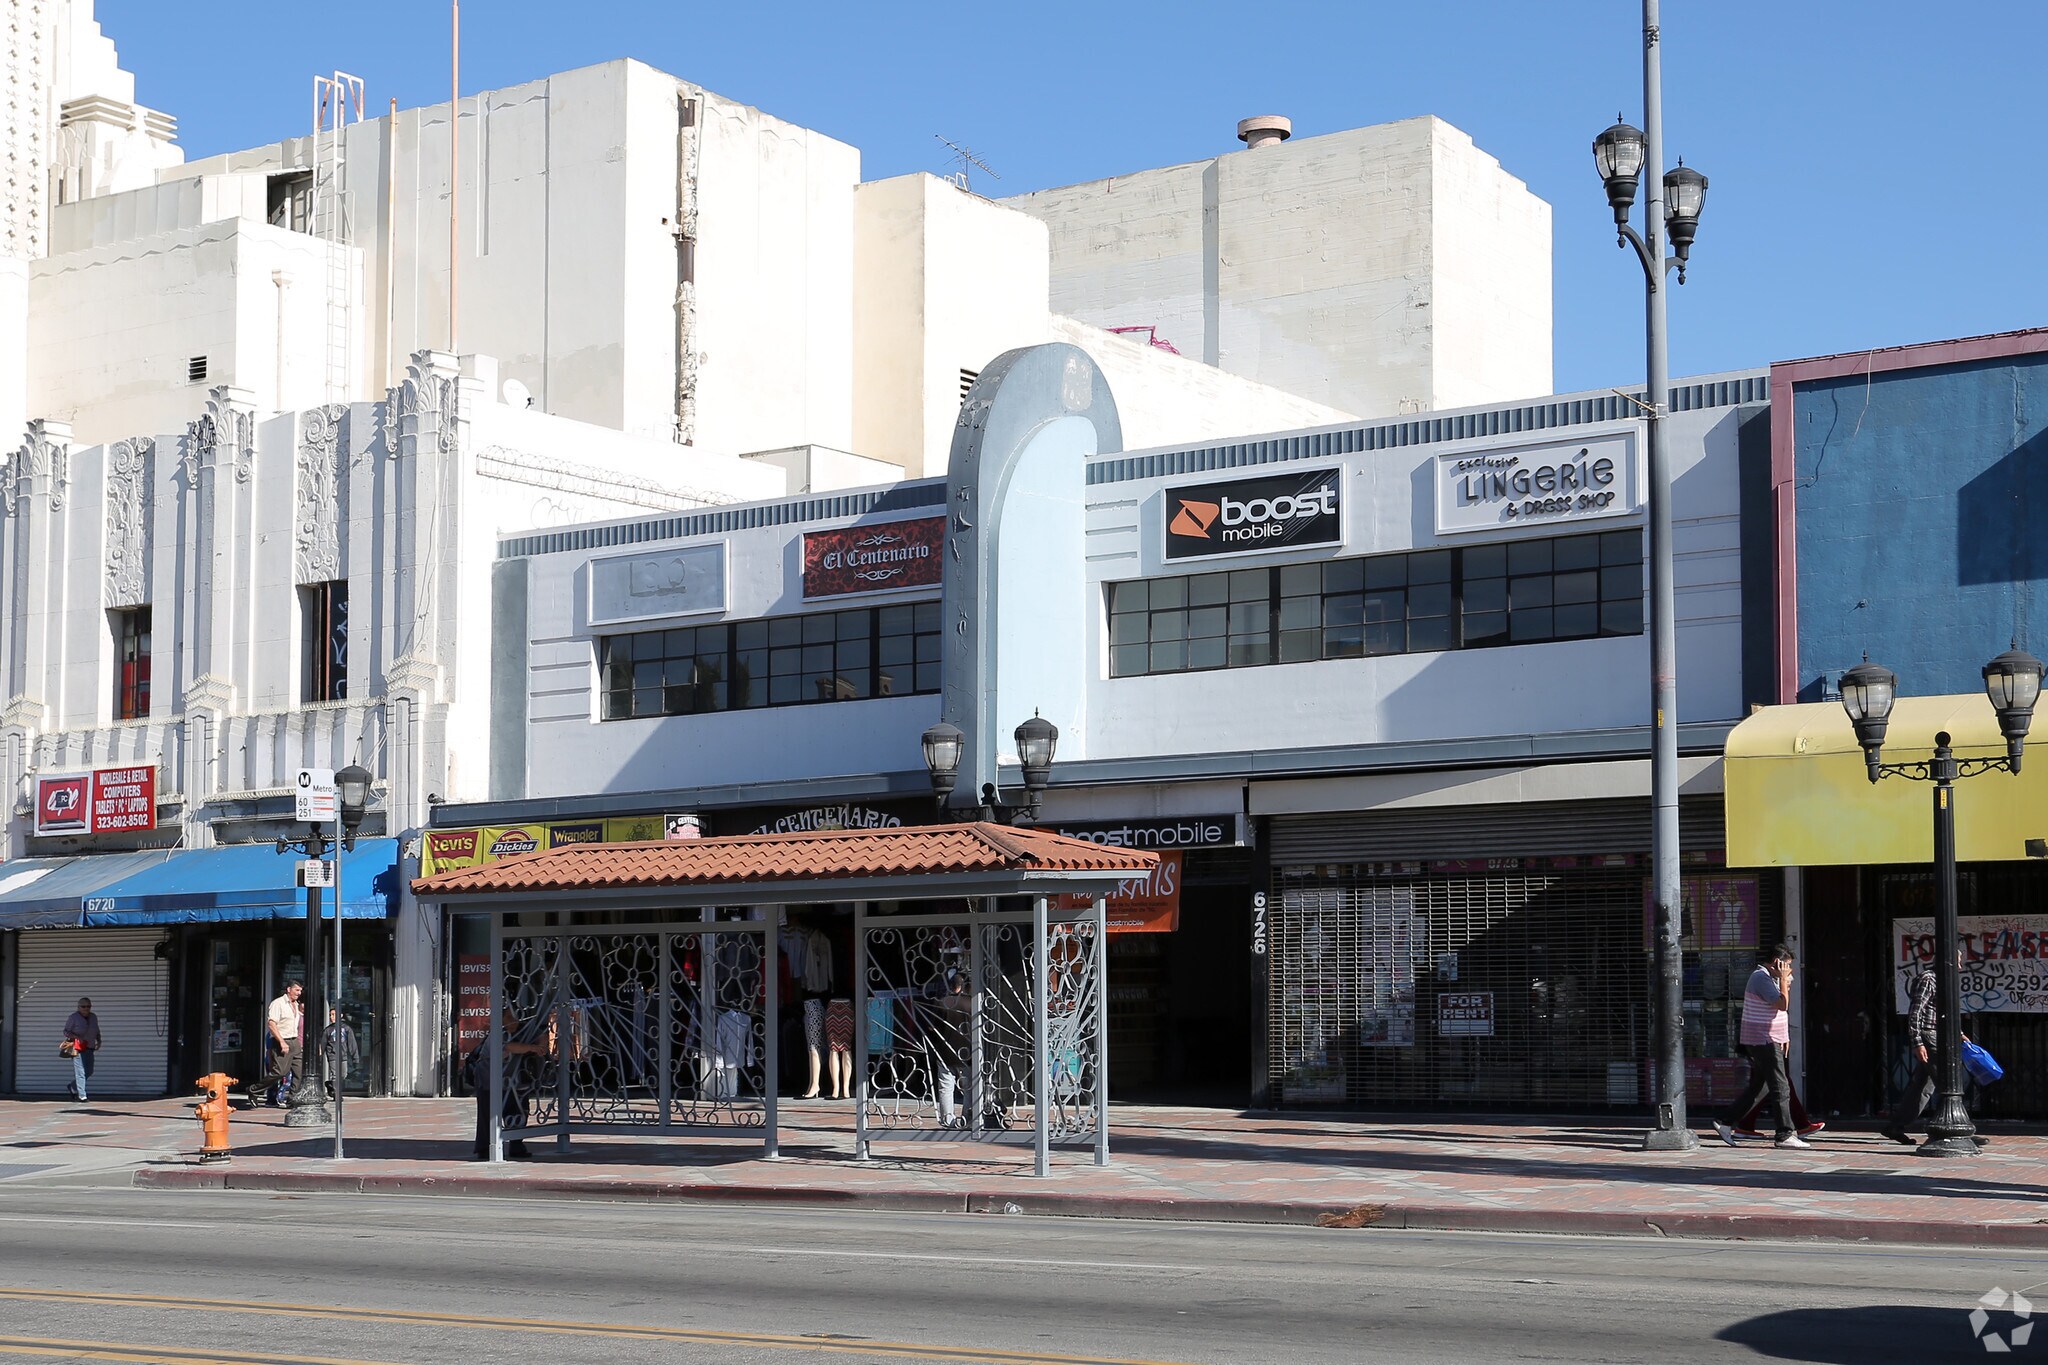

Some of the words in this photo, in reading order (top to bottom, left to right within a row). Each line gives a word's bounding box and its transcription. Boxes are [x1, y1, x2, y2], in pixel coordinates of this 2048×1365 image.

[1457, 455, 1520, 471] Exclusive
[1221, 485, 1335, 526] boost
[1506, 502, 1519, 517] &
[1578, 492, 1615, 509] SHOP
[1222, 523, 1283, 542] mobile
[823, 551, 842, 570] El
[846, 541, 929, 567] Centenario
[99, 771, 126, 786] WHOLESALE
[127, 770, 131, 783] &
[131, 769, 148, 783] RETAIL
[103, 785, 141, 798] COMPUTERS
[313, 785, 333, 793] Metro
[95, 799, 115, 815] TABLETS
[118, 798, 124, 813] PC
[127, 796, 148, 812] LAPTOPS
[298, 797, 308, 807] 60
[96, 813, 148, 829] 323-602-8502
[298, 809, 312, 818] 251
[554, 829, 599, 843] Wrangler
[494, 842, 534, 852] Dickies
[88, 898, 115, 911] 6720
[1253, 891, 1266, 955] 6726
[1901, 933, 1936, 961] FO
[1448, 996, 1483, 1007] FOR
[1442, 1008, 1488, 1019] RENT
